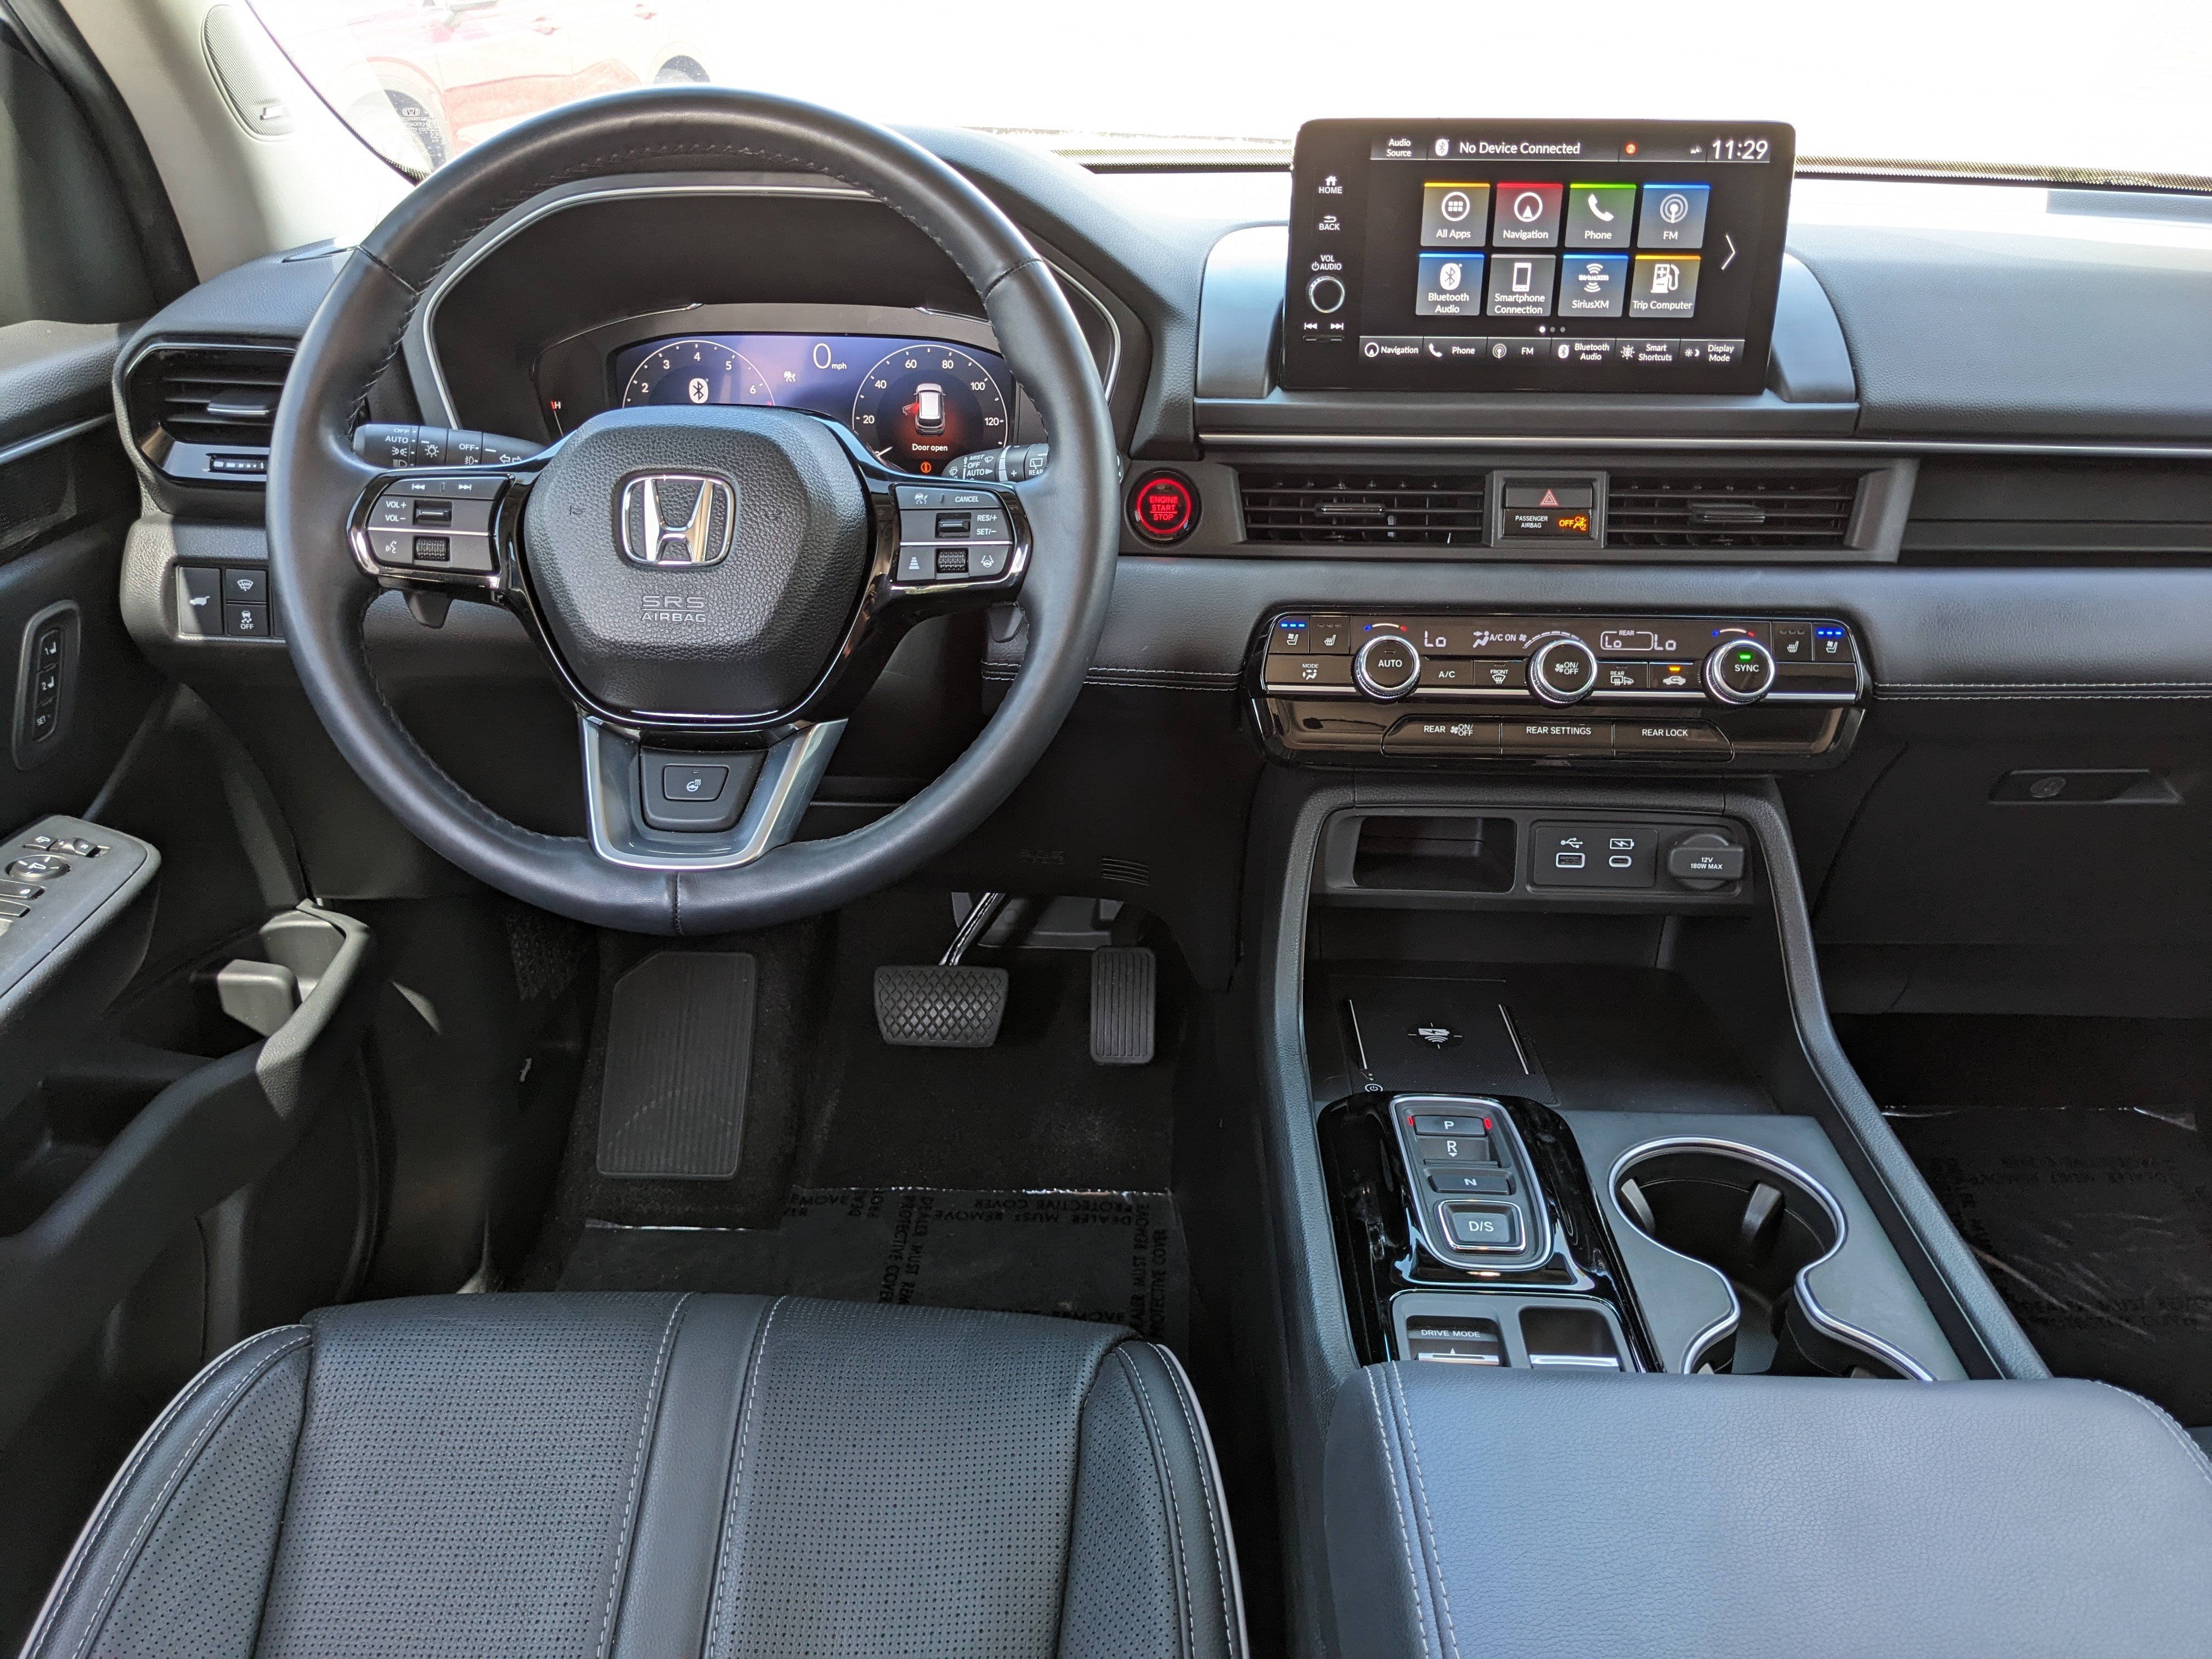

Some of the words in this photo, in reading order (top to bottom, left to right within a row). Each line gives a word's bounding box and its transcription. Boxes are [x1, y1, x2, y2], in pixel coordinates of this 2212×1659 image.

[1389, 138, 1411, 147] Audio
[1459, 142, 1476, 154] No
[1480, 142, 1517, 154] Device
[1520, 142, 1580, 154] Connected
[1712, 140, 1768, 160] 11:29
[1386, 149, 1412, 157] Source
[1436, 229, 1448, 239] All
[1449, 229, 1471, 240] Apps
[1503, 230, 1549, 240] Navigation
[1584, 230, 1612, 240] Phone
[1663, 231, 1678, 240] FM
[1428, 292, 1469, 302] Bluetooth
[1494, 294, 1545, 304] Smartphone
[1435, 304, 1460, 313] Audio
[1572, 300, 1609, 309] SiriusXM
[1633, 301, 1648, 311] Trip
[1650, 301, 1692, 311] Computer
[1494, 305, 1543, 314] Connection
[1381, 346, 1419, 356] Navigation
[1452, 346, 1475, 355] Phone
[1575, 343, 1610, 352] Bluetooth
[1646, 343, 1667, 352] Smart
[1708, 344, 1734, 354] Display
[694, 352, 701, 362] 4
[813, 343, 831, 369] 0
[1580, 352, 1602, 360] Audio
[1638, 353, 1672, 362] Shortcuts
[1709, 353, 1730, 362] Mode
[663, 360, 670, 369] 3
[726, 361, 732, 370] 5
[905, 360, 917, 369] 60
[942, 360, 953, 369] 80
[642, 383, 649, 393] 2
[874, 380, 887, 389] 40
[970, 382, 985, 391] 100
[749, 385, 757, 394] 6
[863, 415, 874, 424] 20
[984, 417, 999, 426] 120
[385, 436, 409, 444] AUTO
[930, 445, 948, 454] open
[967, 469, 985, 477] AUTO
[641, 595, 704, 608] SRS
[641, 612, 706, 623] AIRBAG
[1378, 659, 1402, 668] AUTO
[1734, 664, 1759, 673] SYNC
[1438, 670, 1455, 679] A/C
[42, 681, 47, 691] 2
[1444, 1121, 1454, 1129] P
[1447, 1141, 1457, 1152] R
[974, 1199, 1028, 1210] COVER
[934, 1210, 1003, 1222] REMOVE
[1071, 1212, 1132, 1226] DEALER
[1469, 1221, 1494, 1232] D/S
